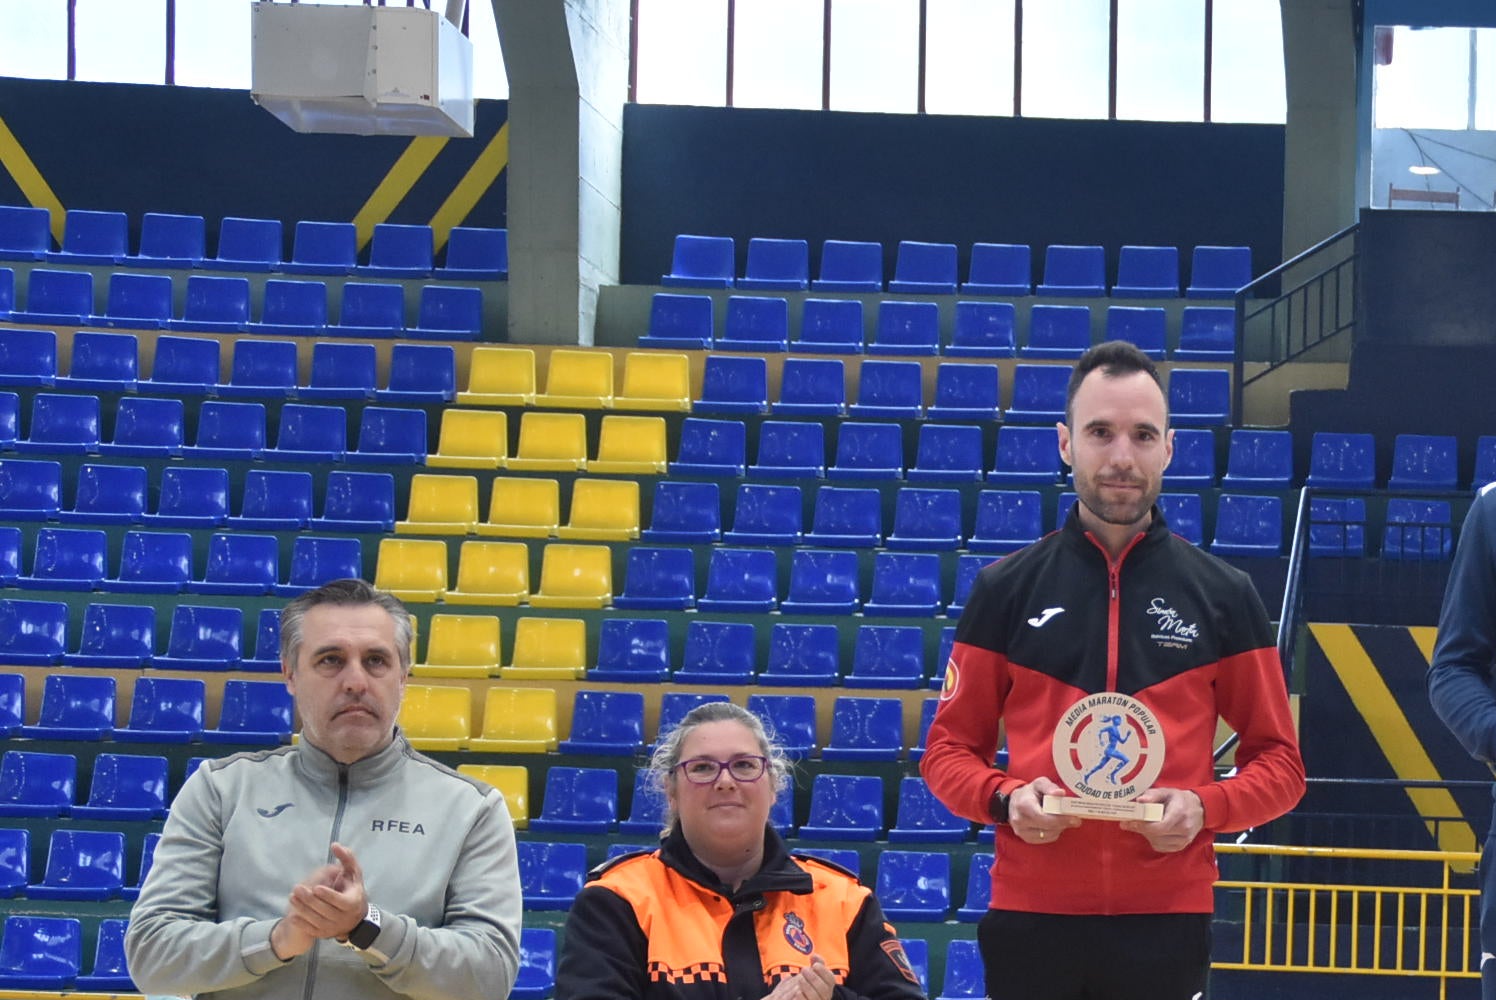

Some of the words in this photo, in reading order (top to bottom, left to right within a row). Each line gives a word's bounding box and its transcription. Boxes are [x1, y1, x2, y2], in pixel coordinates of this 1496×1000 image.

[1066, 706, 1087, 727] MEDIA
[1088, 695, 1129, 708] MARATÓN
[1129, 704, 1155, 735] POPULAR
[1075, 781, 1101, 799] CIUDAD
[1102, 790, 1112, 799] DE
[371, 819, 425, 836] RFEA
